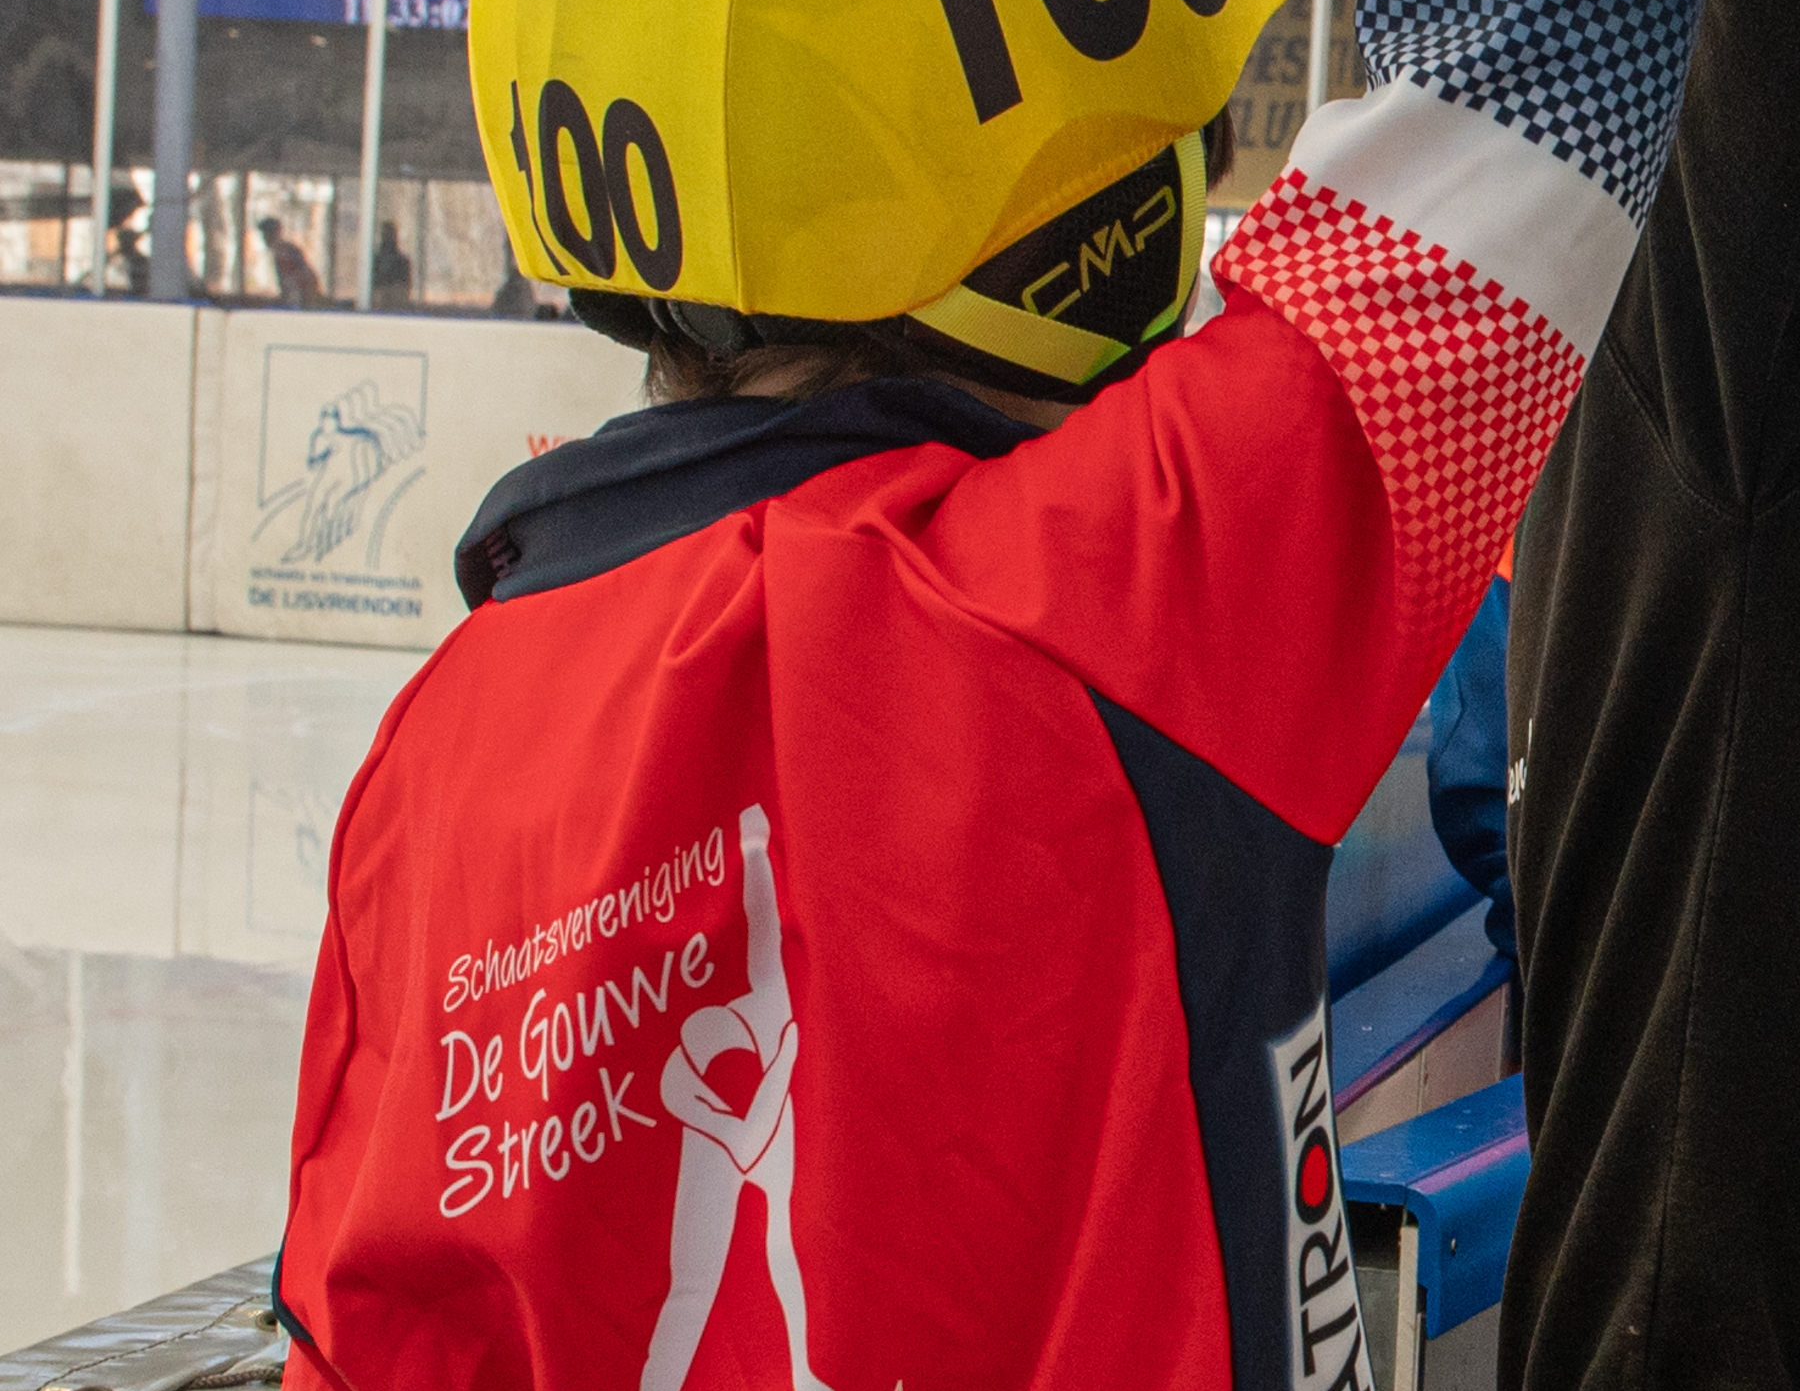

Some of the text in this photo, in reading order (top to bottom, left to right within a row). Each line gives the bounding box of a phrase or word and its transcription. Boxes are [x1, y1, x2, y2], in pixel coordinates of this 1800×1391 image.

[510, 79, 684, 292] 100
[1021, 185, 1176, 320] CMP
[443, 827, 724, 1013] Schaatsvereniging
[436, 933, 715, 1122] De Gouwe
[439, 1067, 657, 1219] Streek
